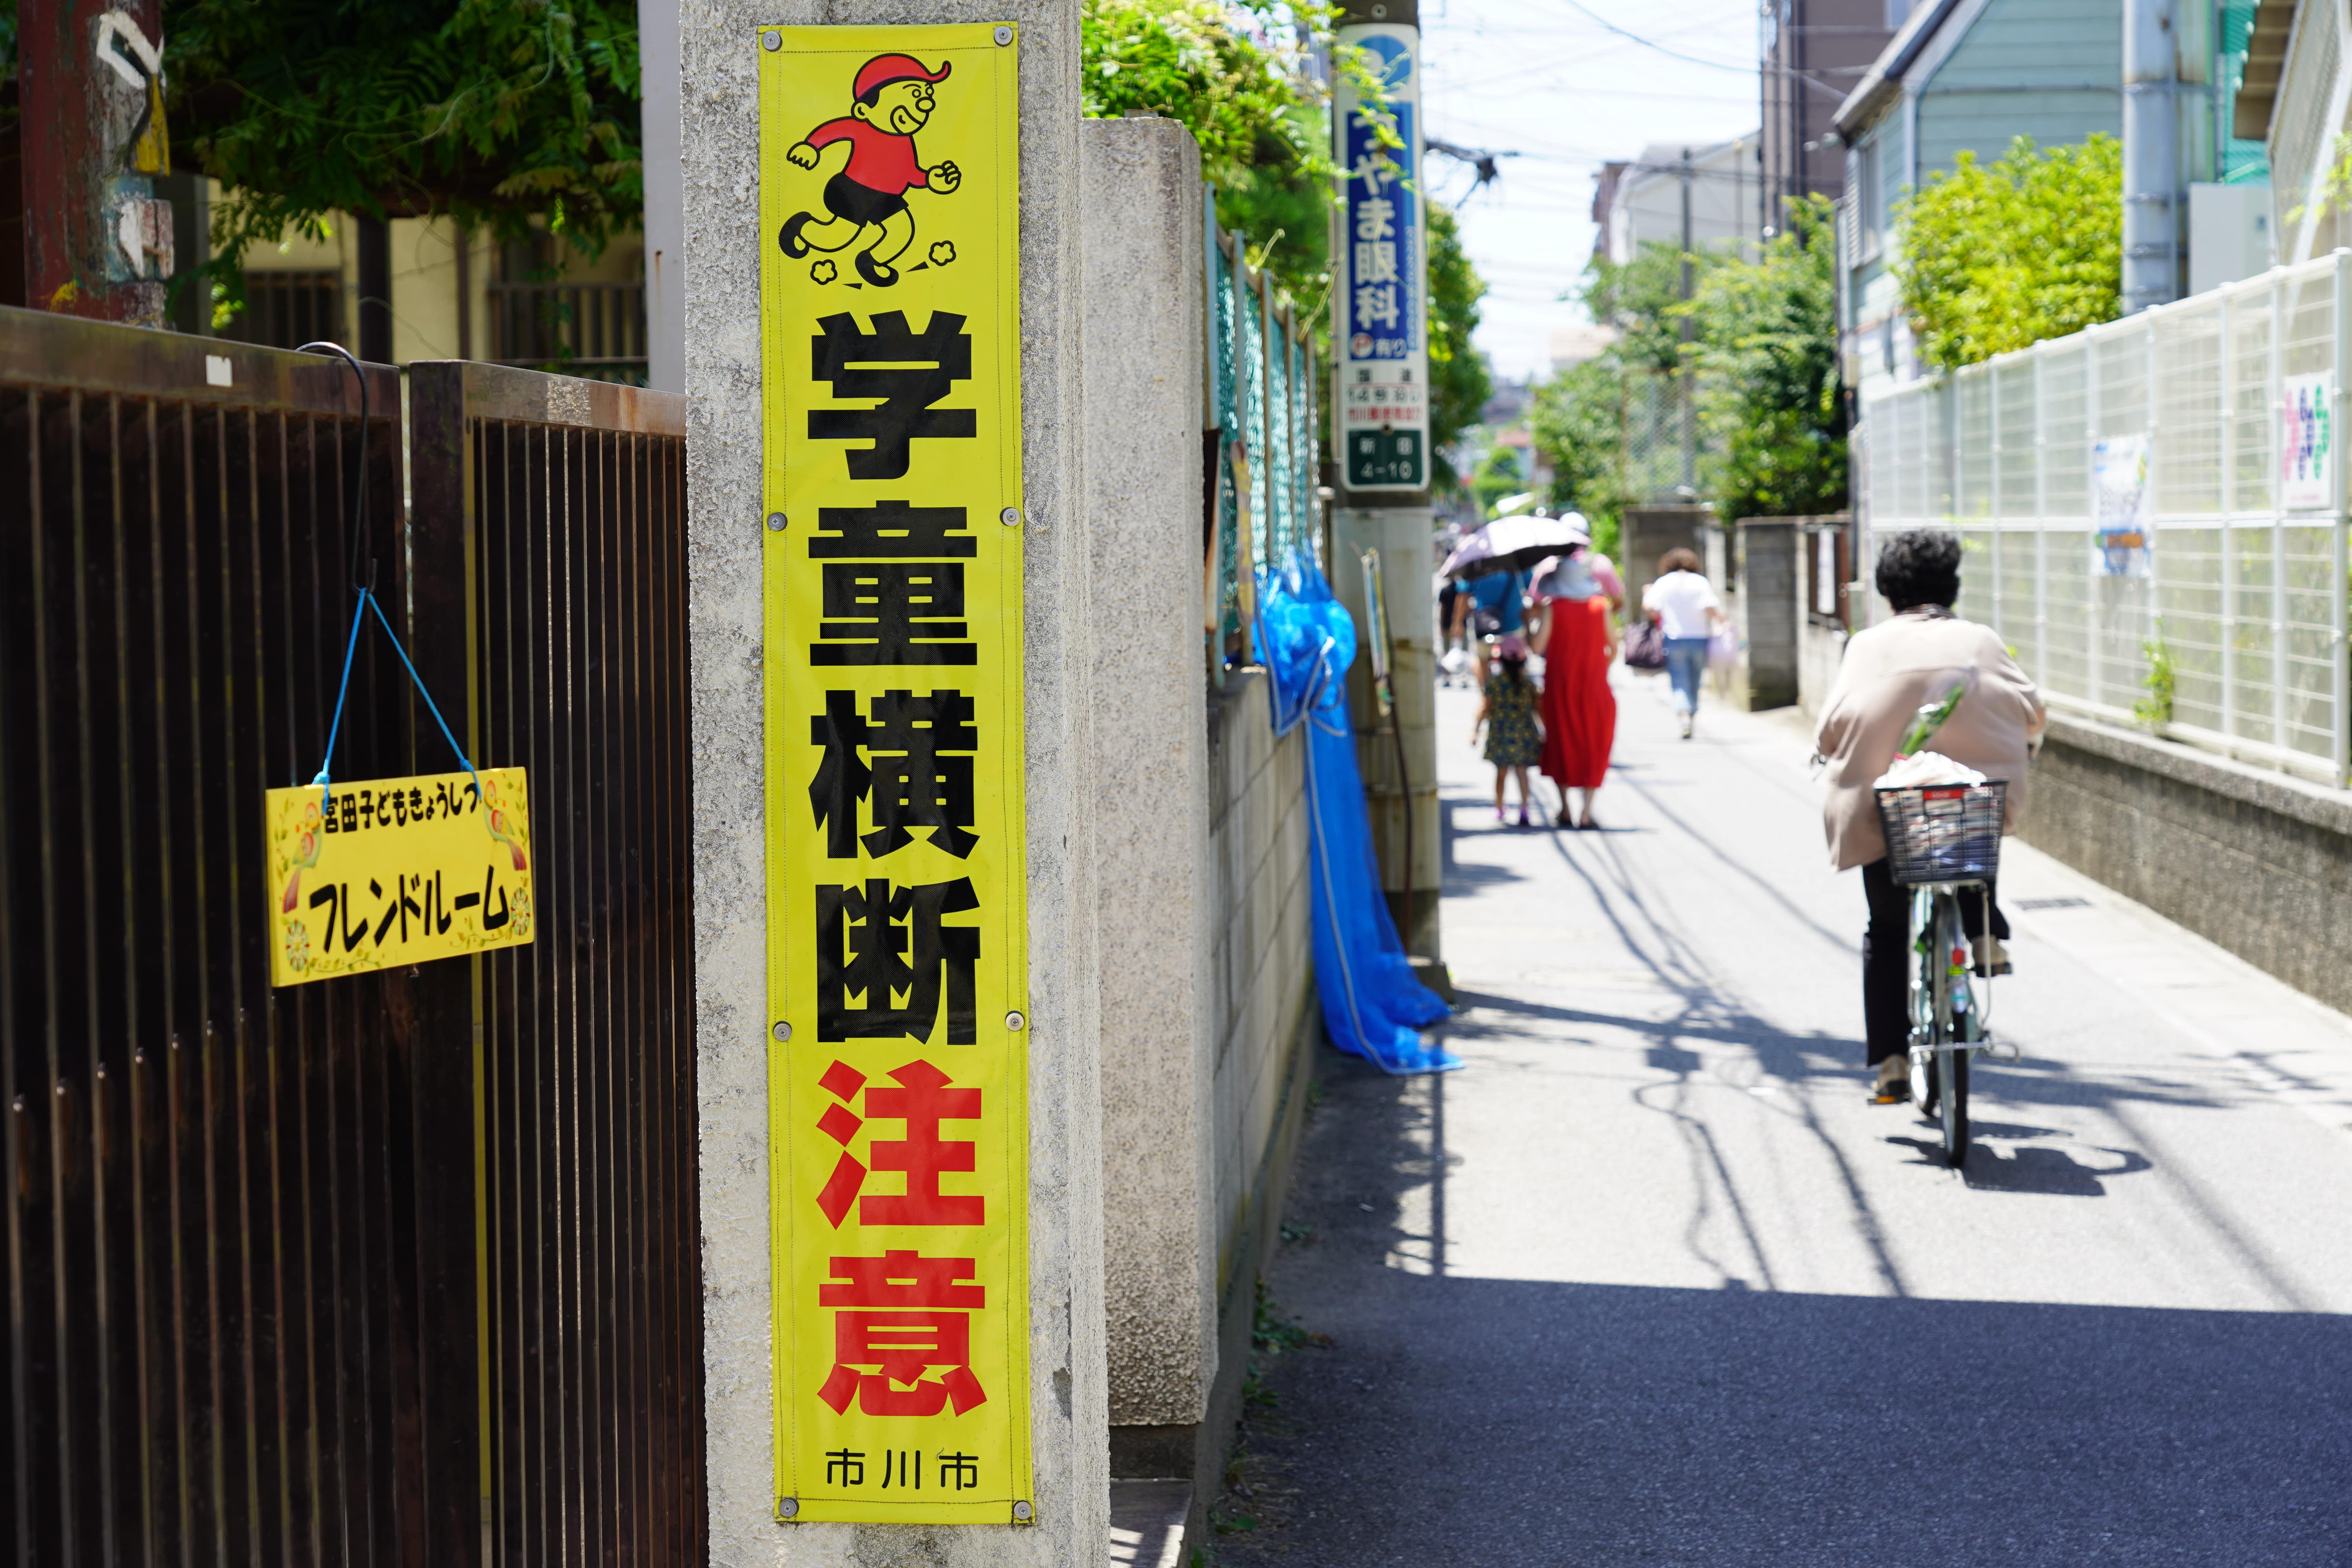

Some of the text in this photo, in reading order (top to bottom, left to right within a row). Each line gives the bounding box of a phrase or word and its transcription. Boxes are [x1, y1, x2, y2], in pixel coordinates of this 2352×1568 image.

[1360, 461, 1412, 480] 4-10
[309, 864, 510, 953] フレンドルーム
[826, 1448, 979, 1490] 市川市
